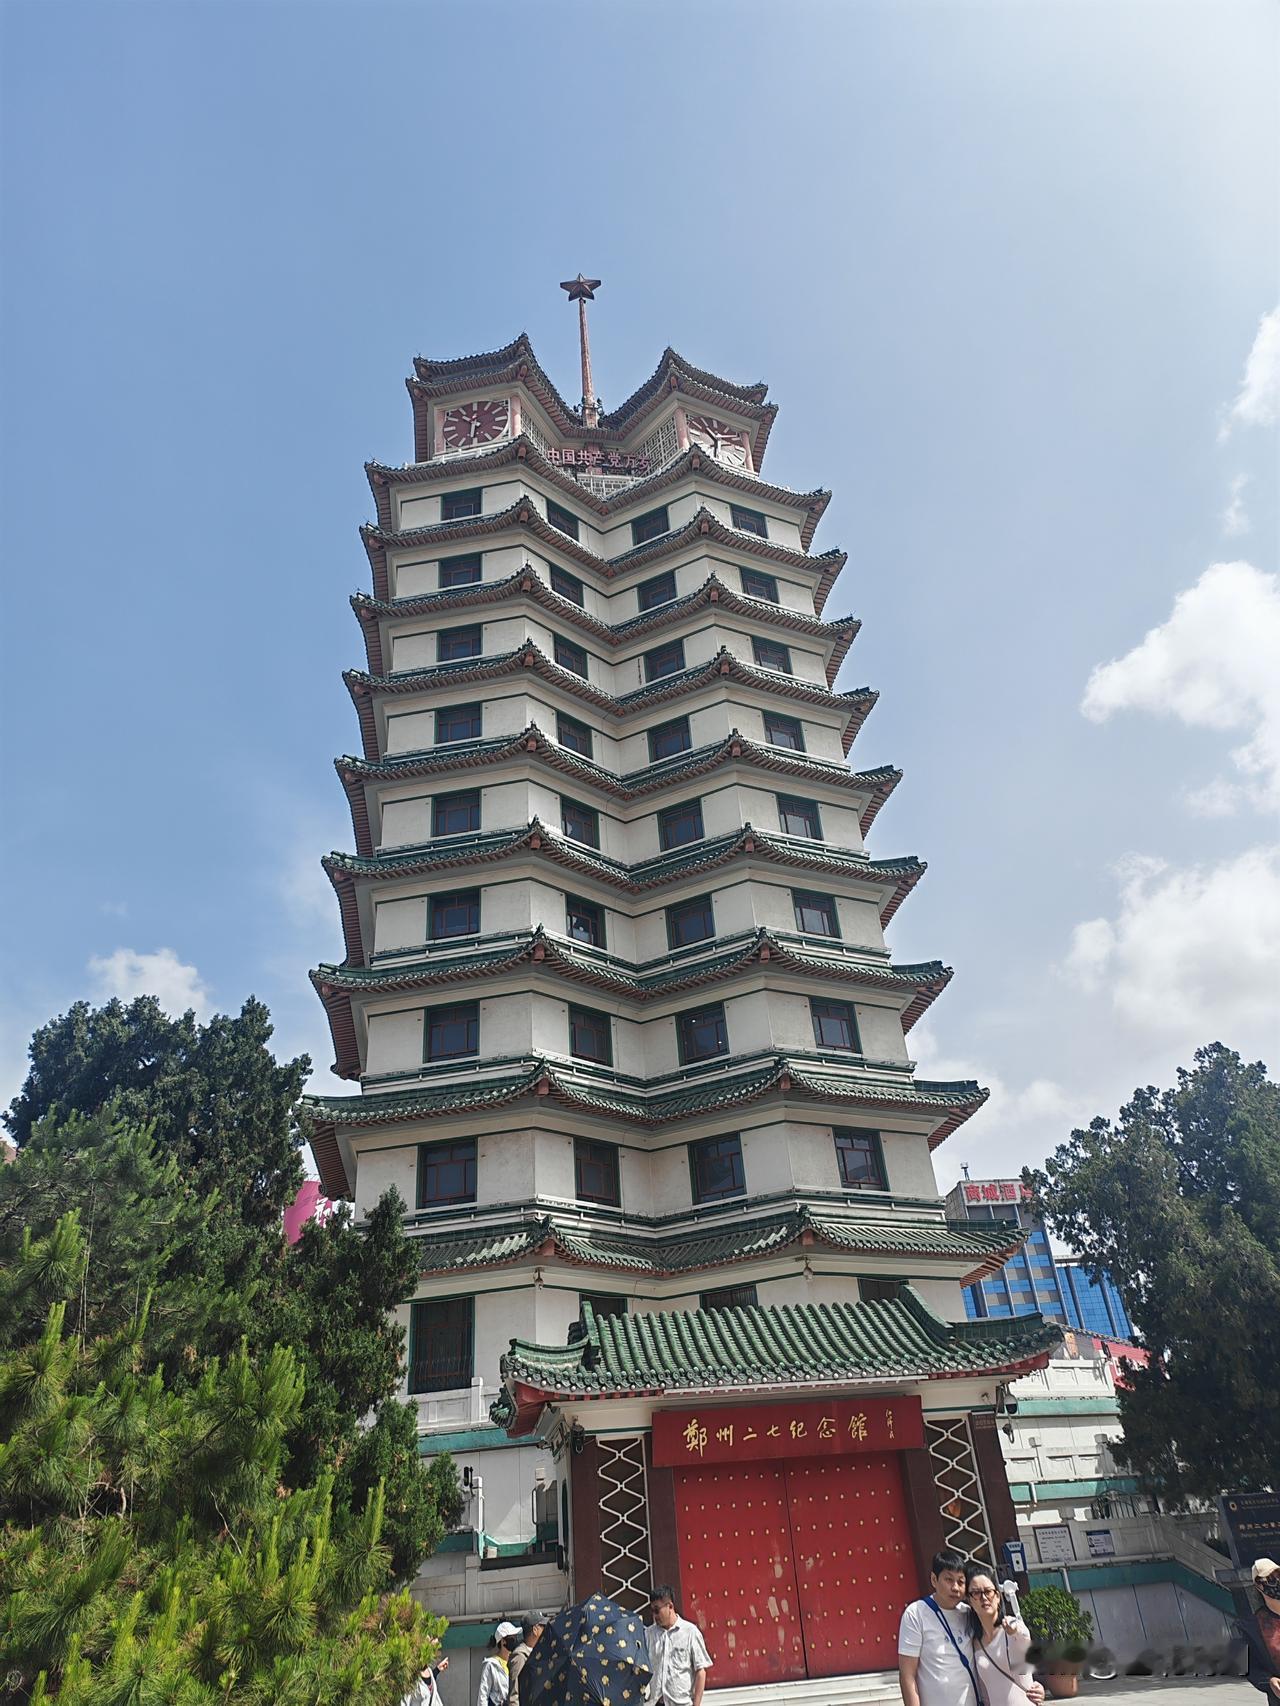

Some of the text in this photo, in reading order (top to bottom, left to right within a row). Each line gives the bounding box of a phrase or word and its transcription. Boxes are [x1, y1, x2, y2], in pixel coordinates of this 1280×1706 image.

[547, 448, 650, 470] 中国共产党万岁
